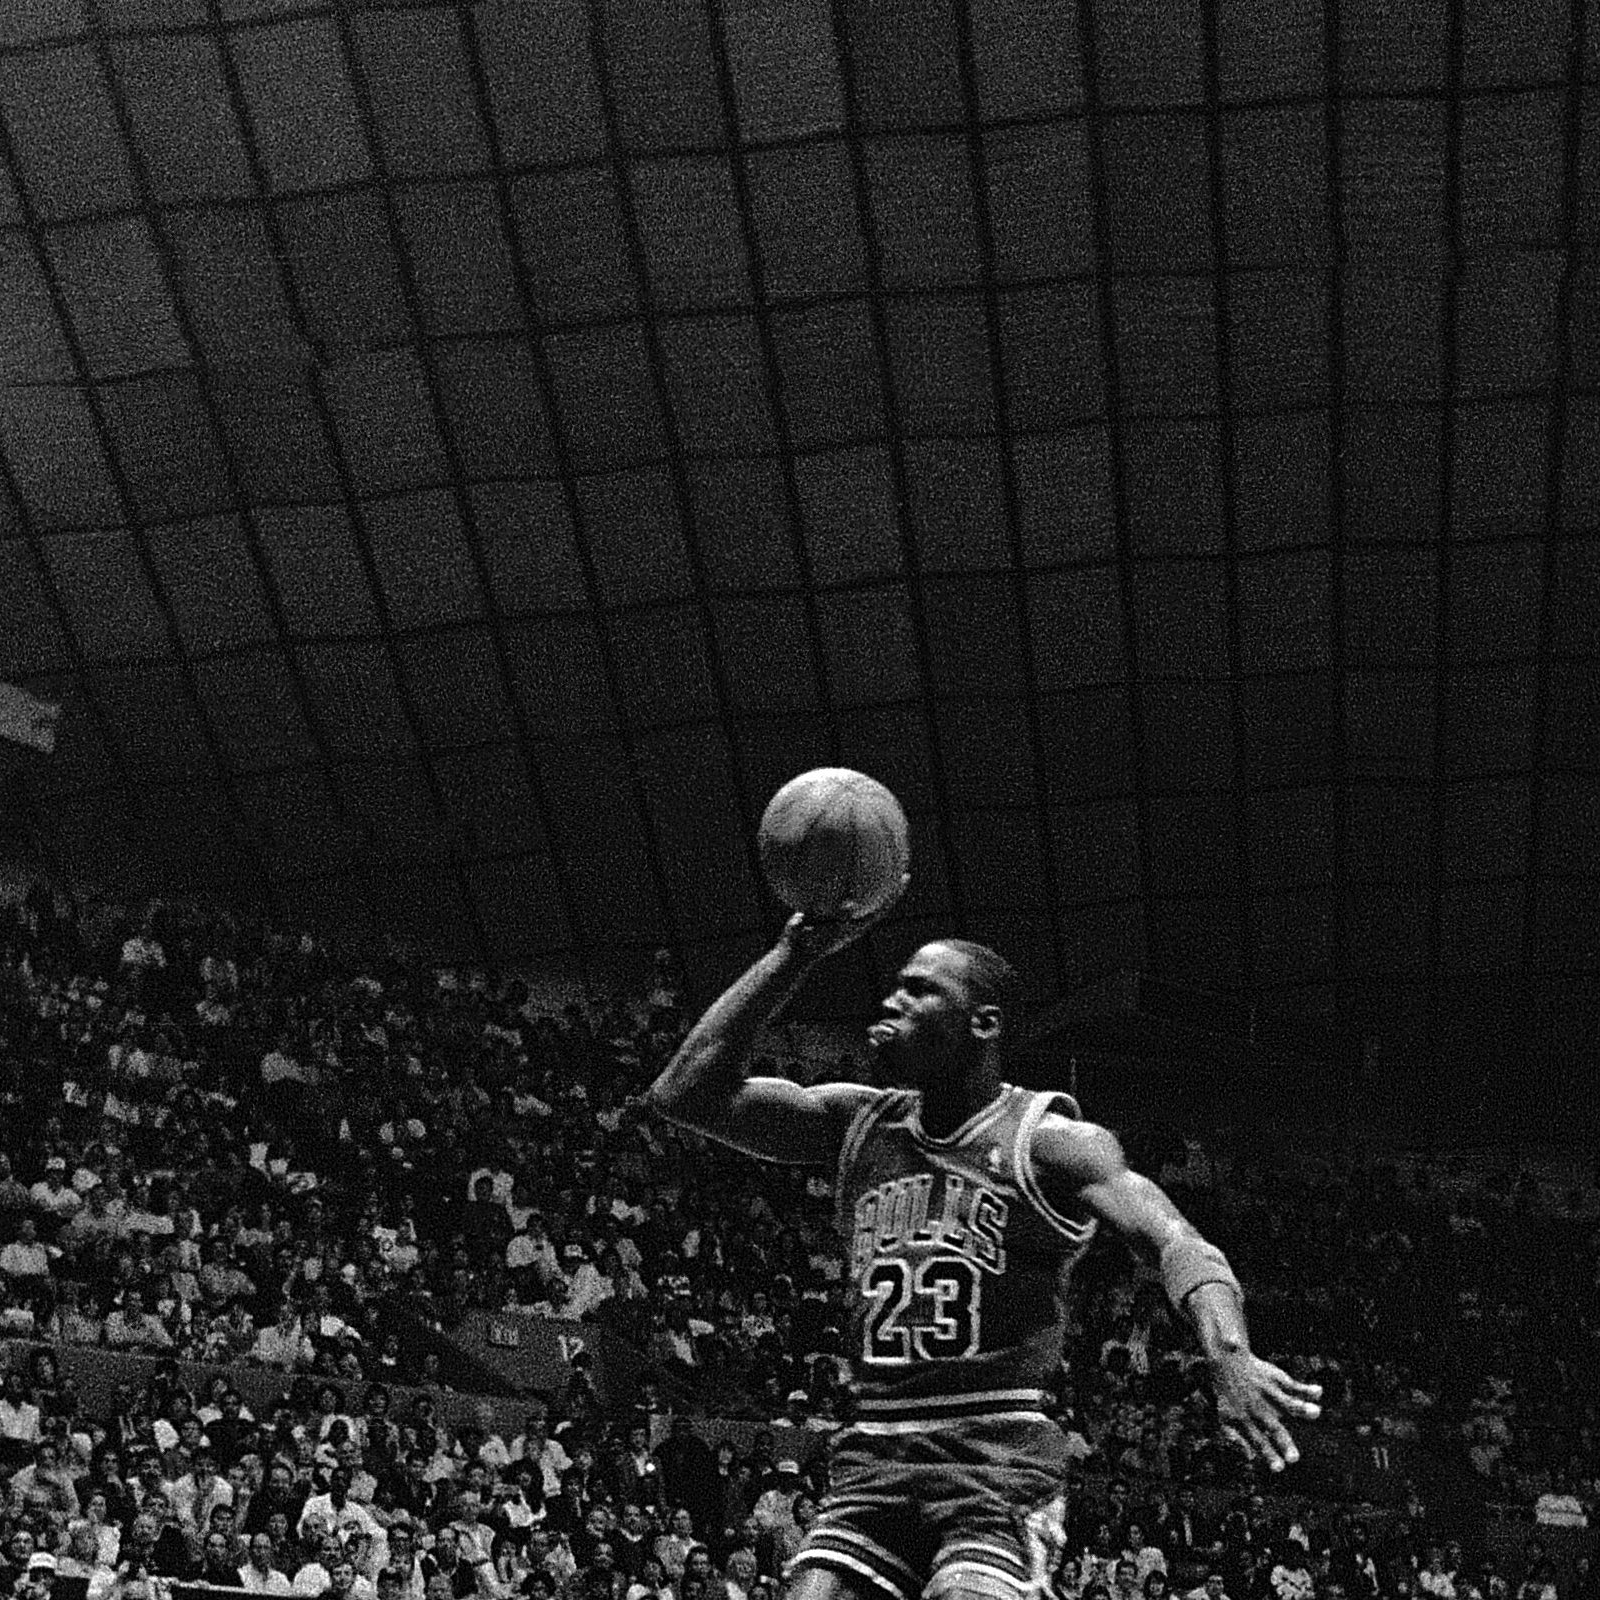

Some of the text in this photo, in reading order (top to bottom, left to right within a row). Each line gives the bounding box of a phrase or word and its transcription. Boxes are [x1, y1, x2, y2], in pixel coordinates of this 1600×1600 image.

[849, 1172, 1009, 1278] BULLS
[862, 1255, 981, 1364] 23
[1369, 1445, 1390, 1470] 11
